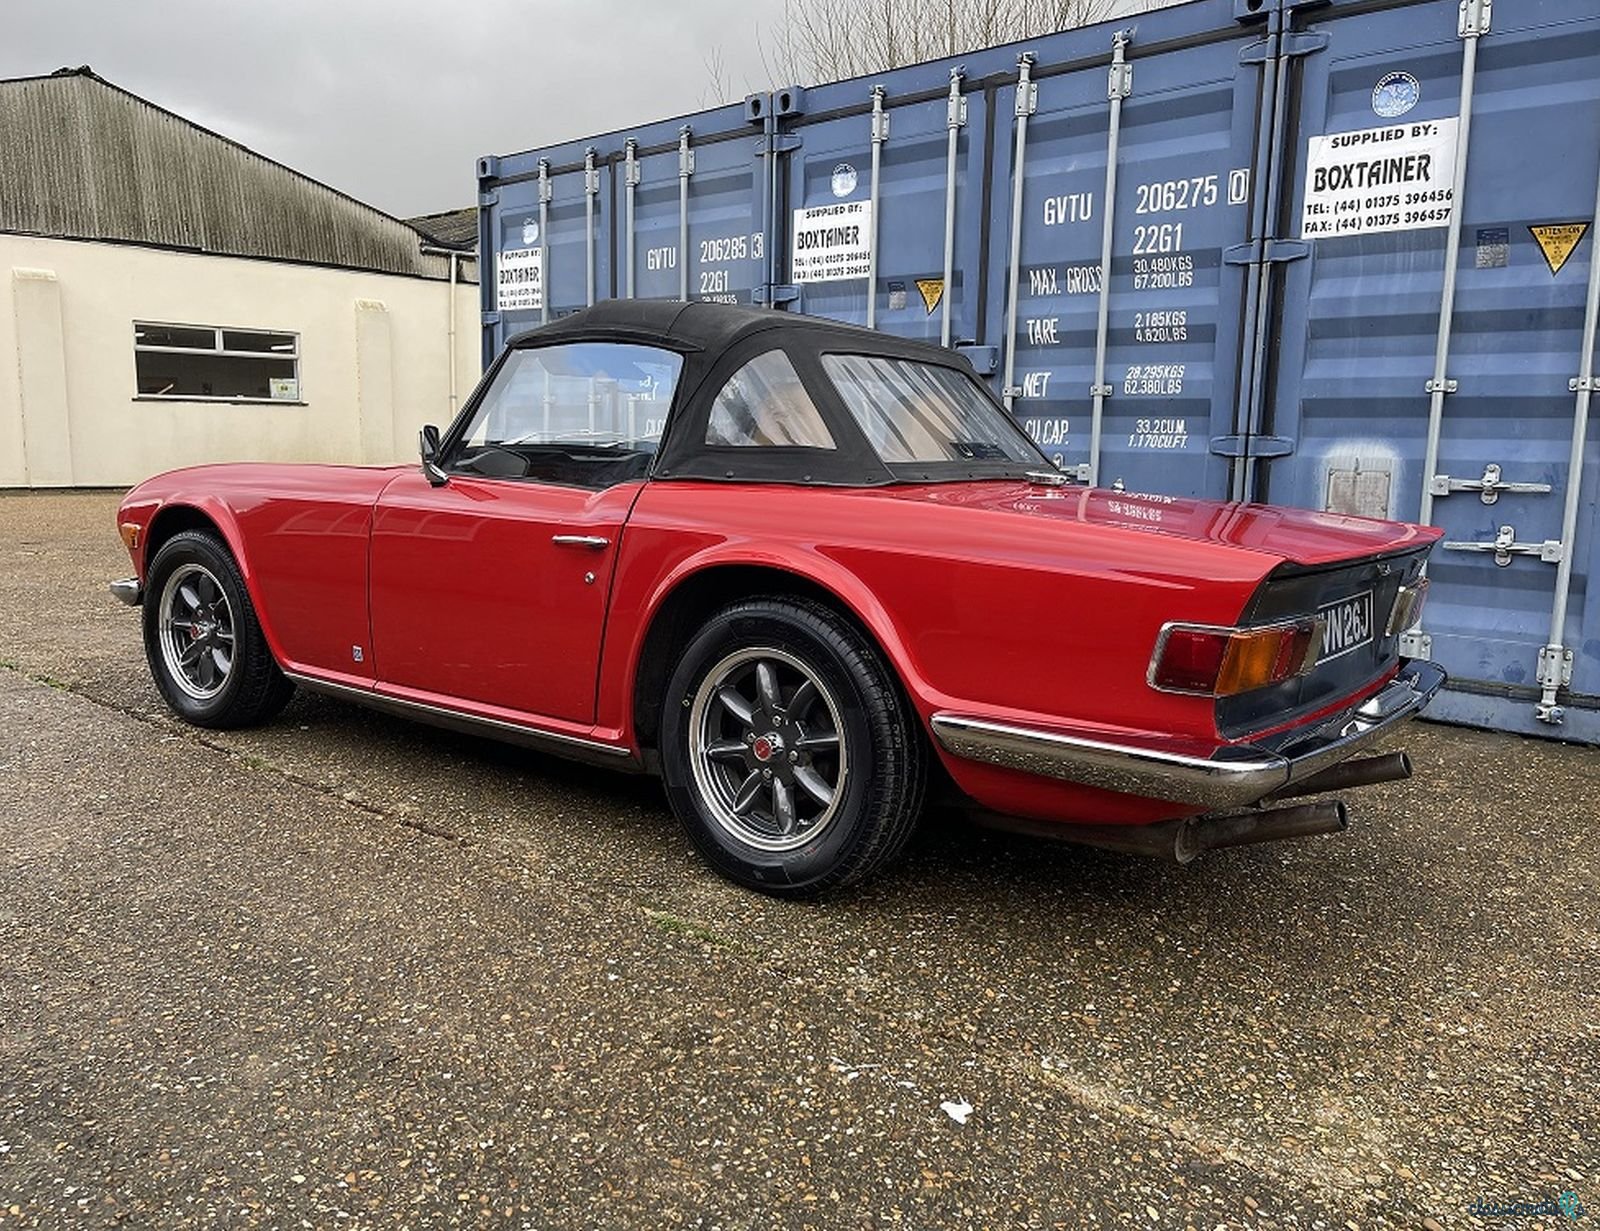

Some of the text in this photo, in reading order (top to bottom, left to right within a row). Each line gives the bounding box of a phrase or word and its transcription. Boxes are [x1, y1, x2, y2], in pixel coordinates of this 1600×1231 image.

[1331, 124, 1438, 149] SUPPLIED BY:
[1313, 153, 1431, 193] BOXTAINER
[806, 206, 845, 219] SUPPLIED
[1044, 192, 1092, 226] GVTU
[1135, 174, 1218, 215] 206275
[1306, 188, 1453, 216] TEL: (44) 01375 396456
[1304, 207, 1452, 234] FAX: (44) 01375 396457
[797, 225, 860, 250] BOXTAINER
[1132, 223, 1183, 255] 22G1
[647, 246, 676, 270] GVTU
[700, 236, 747, 263] 206285
[700, 270, 729, 294] 22G1
[1030, 268, 1061, 296] MAX.
[1026, 318, 1060, 345] TARE
[1023, 372, 1052, 398] NET
